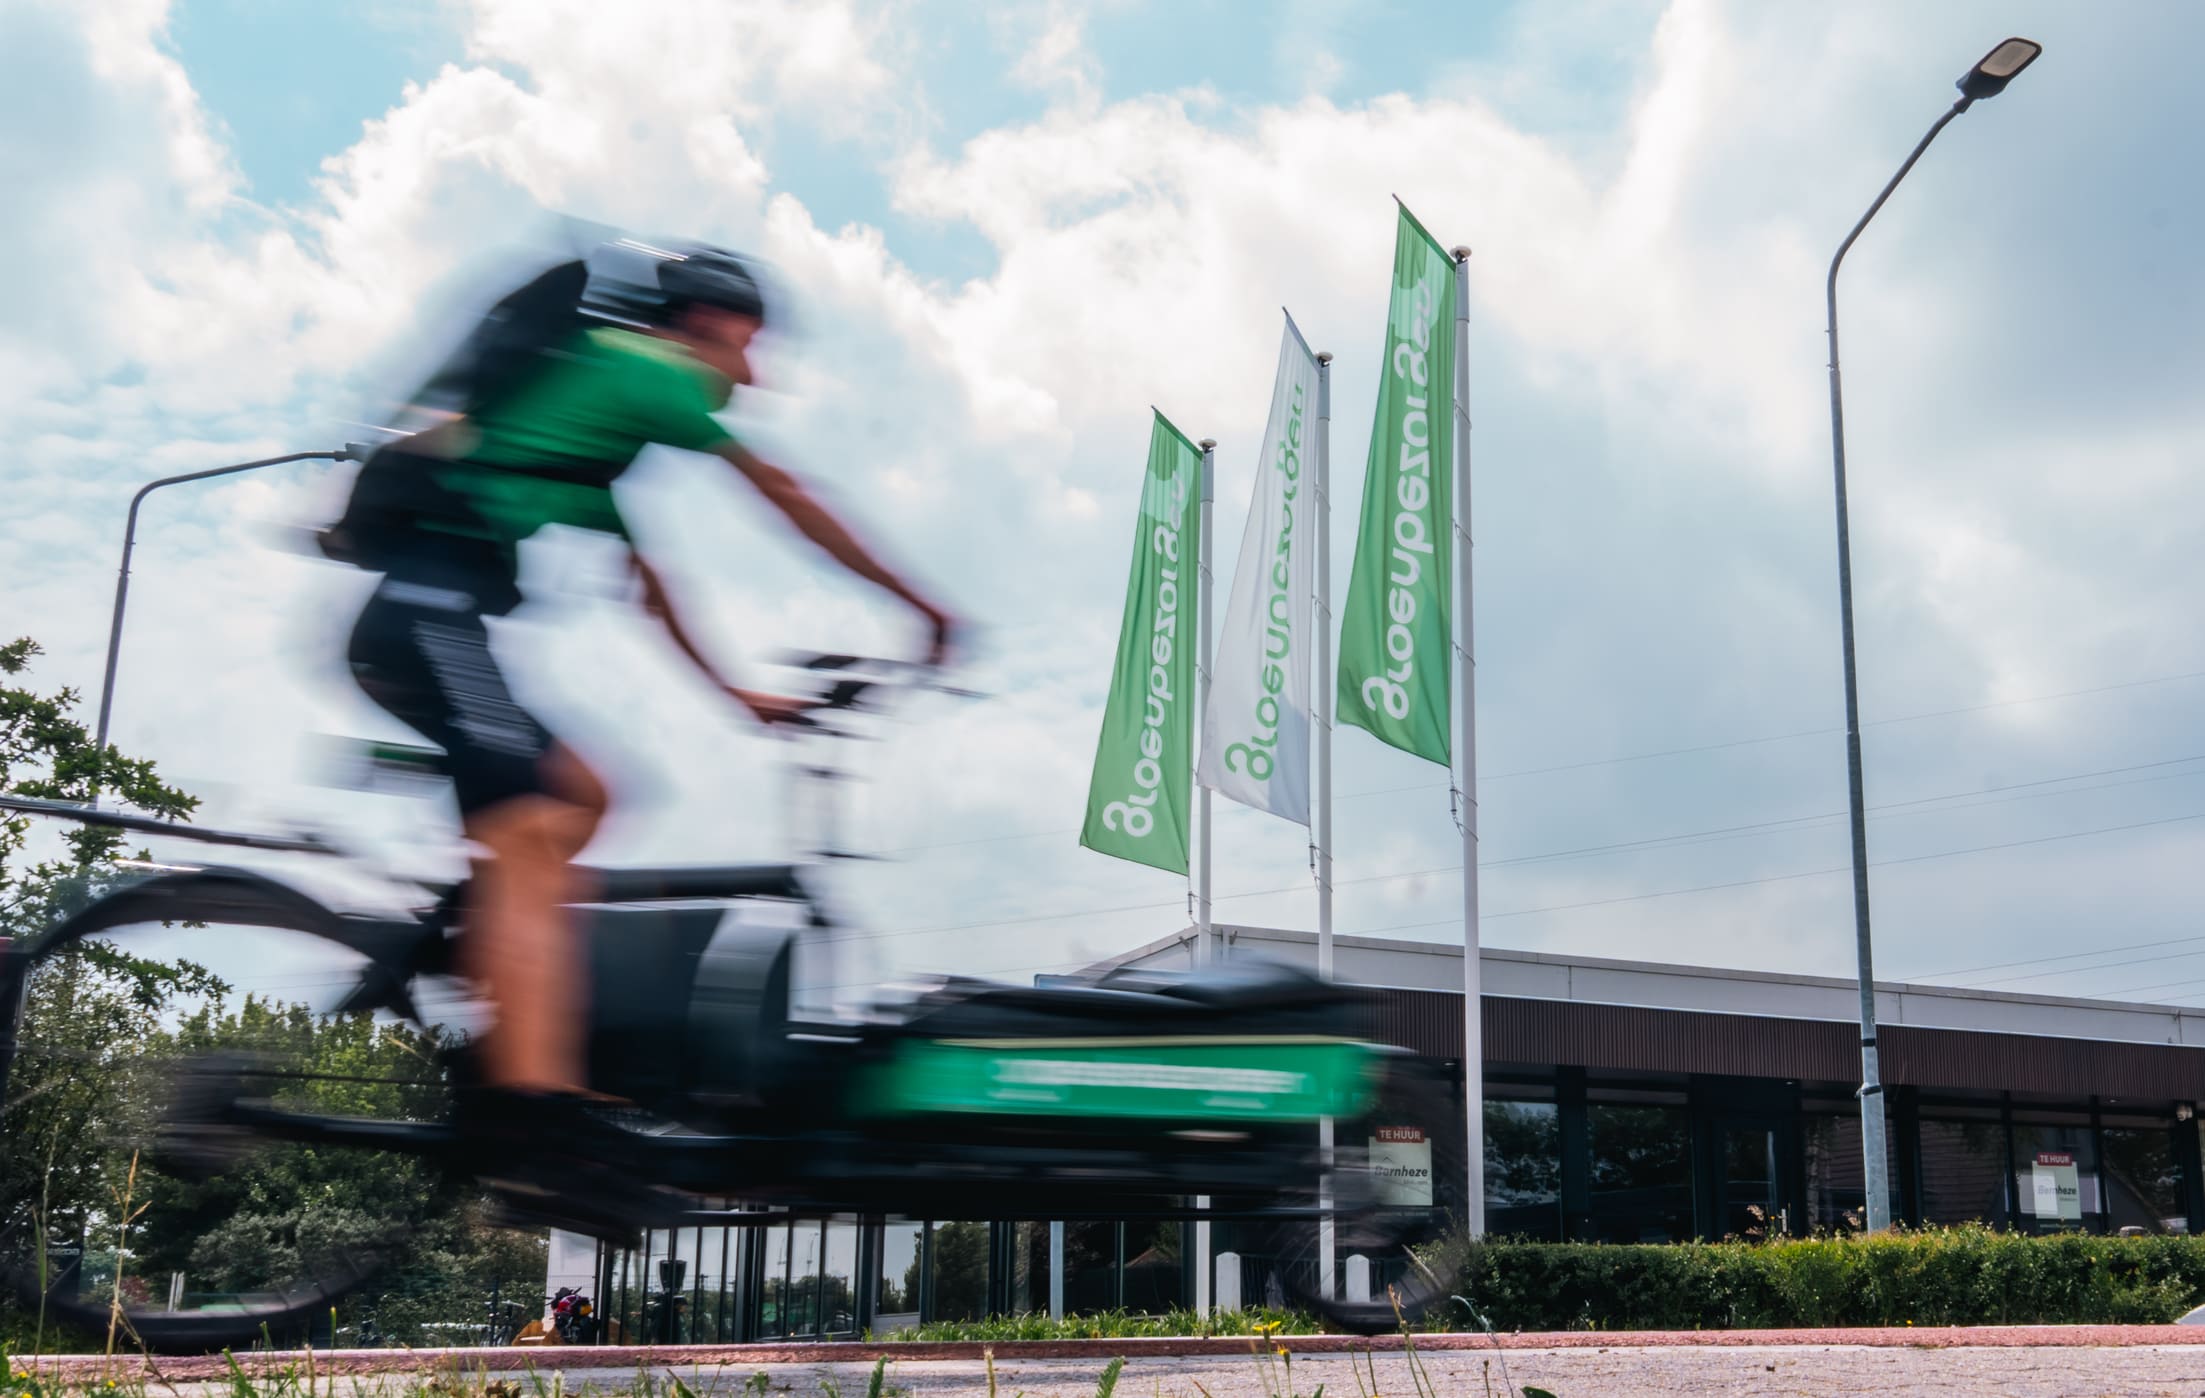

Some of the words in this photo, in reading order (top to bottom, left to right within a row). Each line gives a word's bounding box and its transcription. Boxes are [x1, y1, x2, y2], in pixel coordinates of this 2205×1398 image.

[1379, 1130, 1392, 1139] TE
[1393, 1130, 1421, 1140] HUUR
[2040, 1155, 2049, 1163] TE
[2050, 1155, 2070, 1163] HUUR
